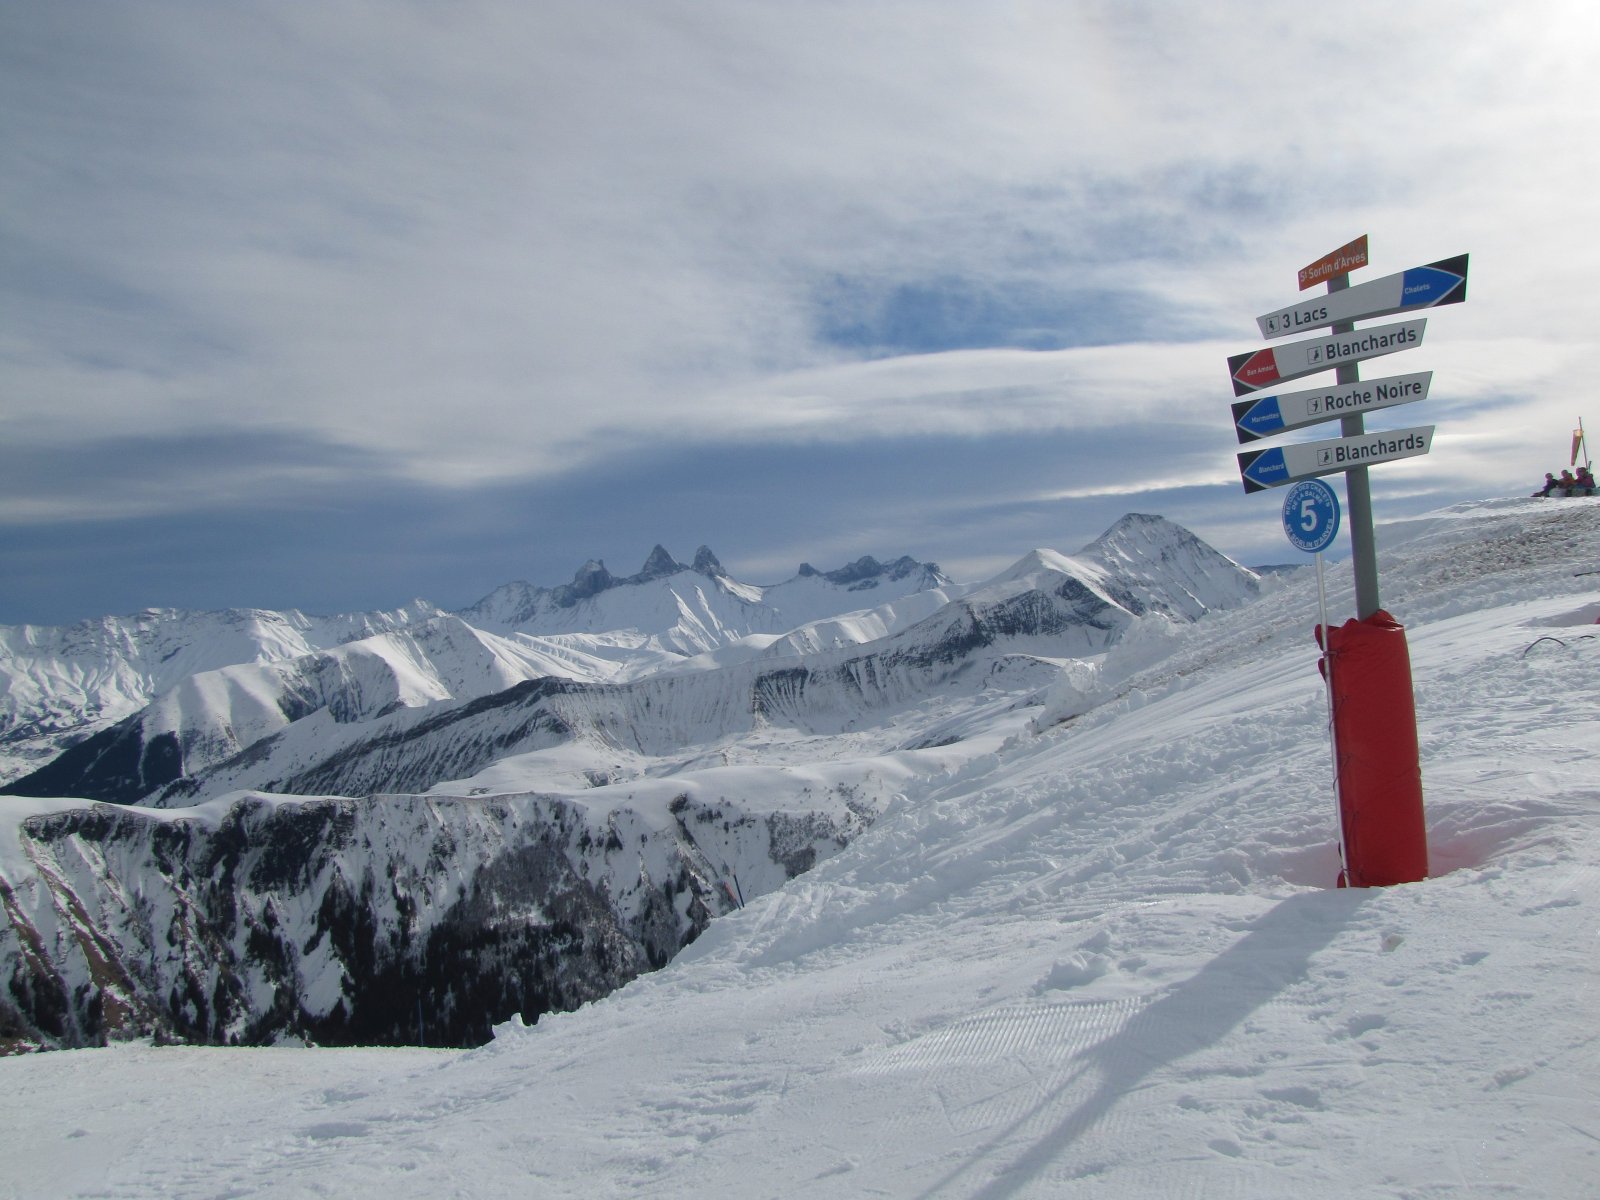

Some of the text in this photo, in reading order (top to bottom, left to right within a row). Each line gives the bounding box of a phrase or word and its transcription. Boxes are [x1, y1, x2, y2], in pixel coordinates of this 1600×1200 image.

[1309, 262, 1333, 279] Sorlin
[1334, 252, 1366, 270] d'Arves
[1404, 282, 1431, 295] Chalets
[1282, 307, 1328, 328] 3 Lacs
[1325, 327, 1417, 360] Blanchards
[1324, 381, 1422, 412] Roche Noire
[1251, 412, 1280, 424] Marmottes
[1335, 433, 1425, 463] Blanchards
[1298, 483, 1310, 492] DES
[1300, 498, 1317, 532] 5
[1291, 531, 1313, 548] SORLIN
